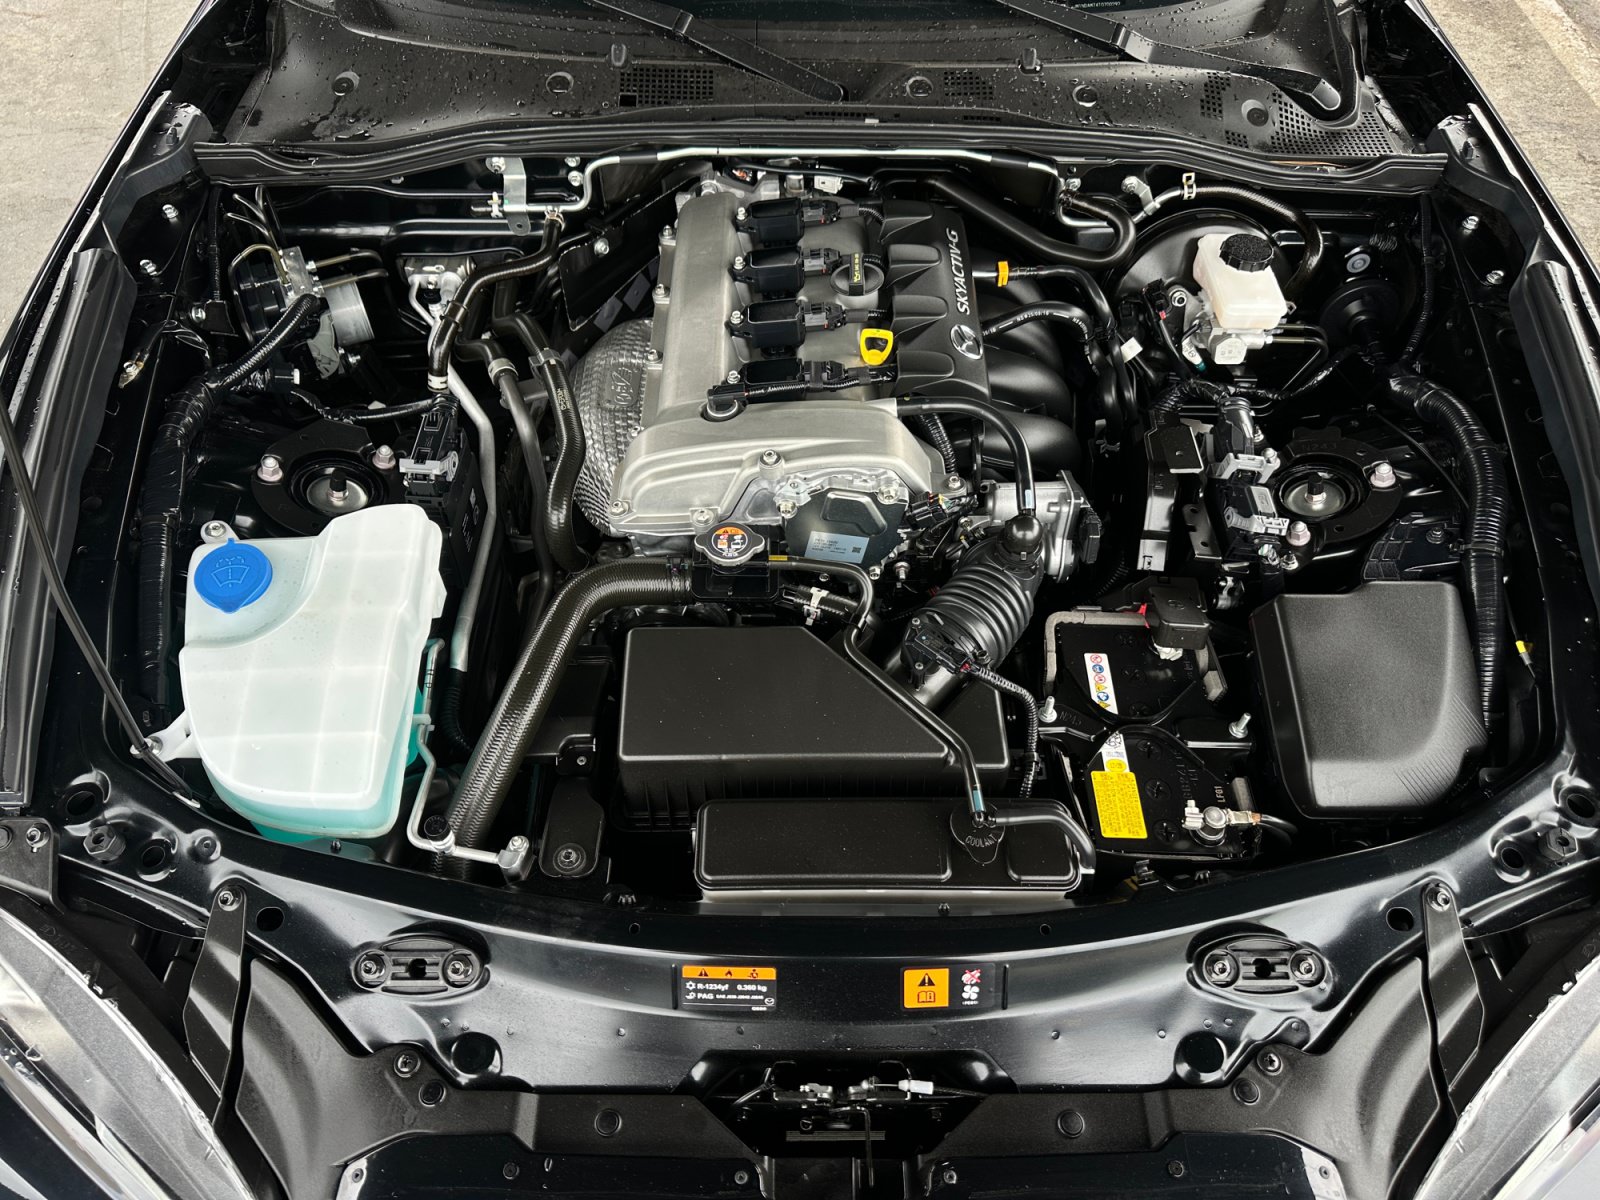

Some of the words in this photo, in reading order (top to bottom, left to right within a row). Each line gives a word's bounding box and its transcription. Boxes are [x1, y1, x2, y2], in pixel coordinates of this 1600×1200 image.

[946, 227, 970, 316] SKYACTIV-G
[964, 833, 998, 848] COOLANT
[697, 983, 729, 992] R-1234yf
[757, 984, 767, 992] kg
[697, 992, 714, 1000] PAG
